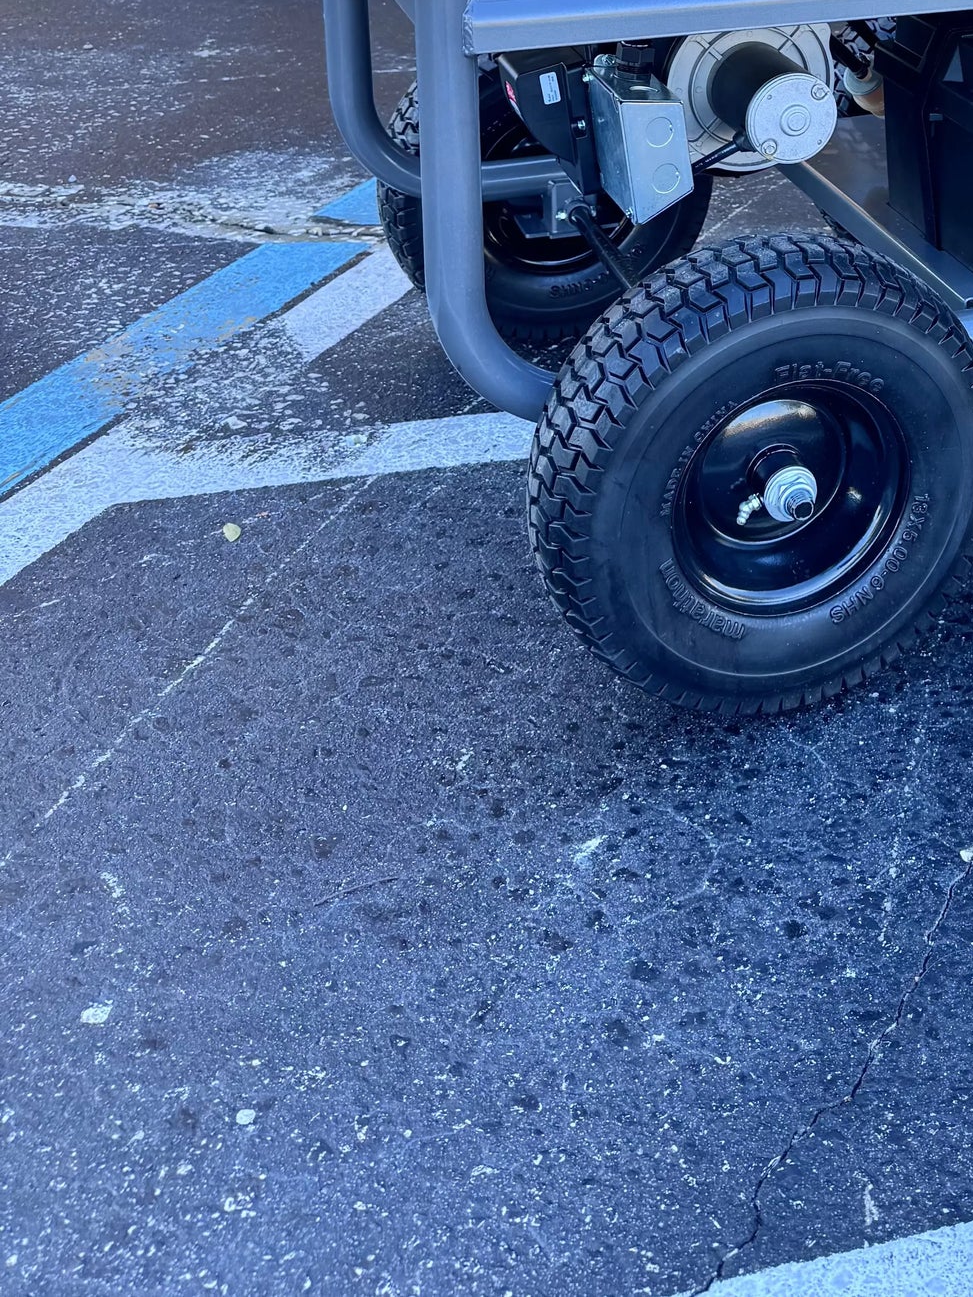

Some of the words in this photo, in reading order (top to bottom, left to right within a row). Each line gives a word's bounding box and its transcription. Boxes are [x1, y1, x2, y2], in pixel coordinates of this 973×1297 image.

[774, 360, 885, 393] Flat-Free
[659, 557, 746, 640] marathon
[829, 585, 874, 625] NHS
